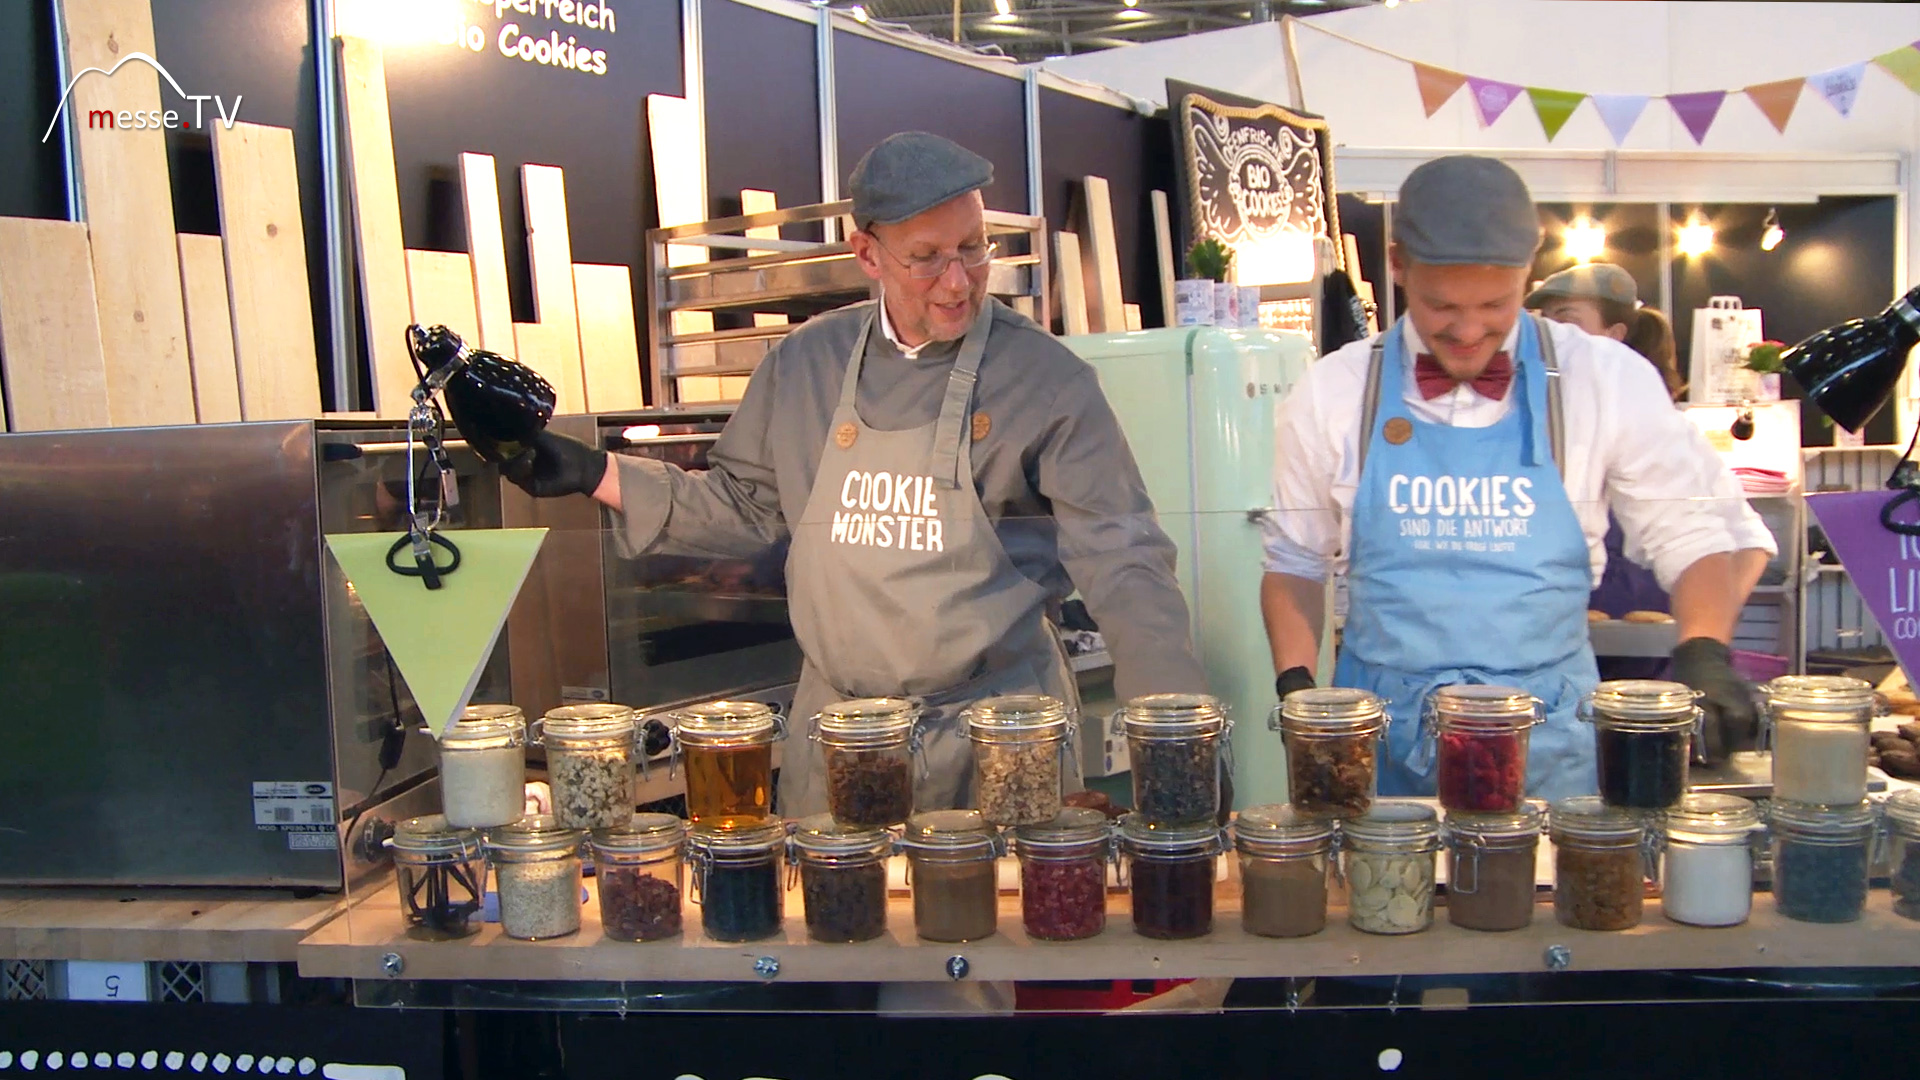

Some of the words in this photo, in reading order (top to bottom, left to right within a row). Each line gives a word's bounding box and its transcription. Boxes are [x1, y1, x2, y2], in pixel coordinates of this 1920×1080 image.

[498, 23, 607, 75] Cookies
[1247, 164, 1271, 188] BIO
[841, 470, 938, 517] COOKIE
[1389, 474, 1536, 517] COOKIES
[831, 511, 944, 552] MONSTER
[1400, 518, 1430, 537] SIND
[1436, 519, 1457, 537] DIE
[1889, 567, 1920, 613] LI
[1894, 617, 1920, 639] CO
